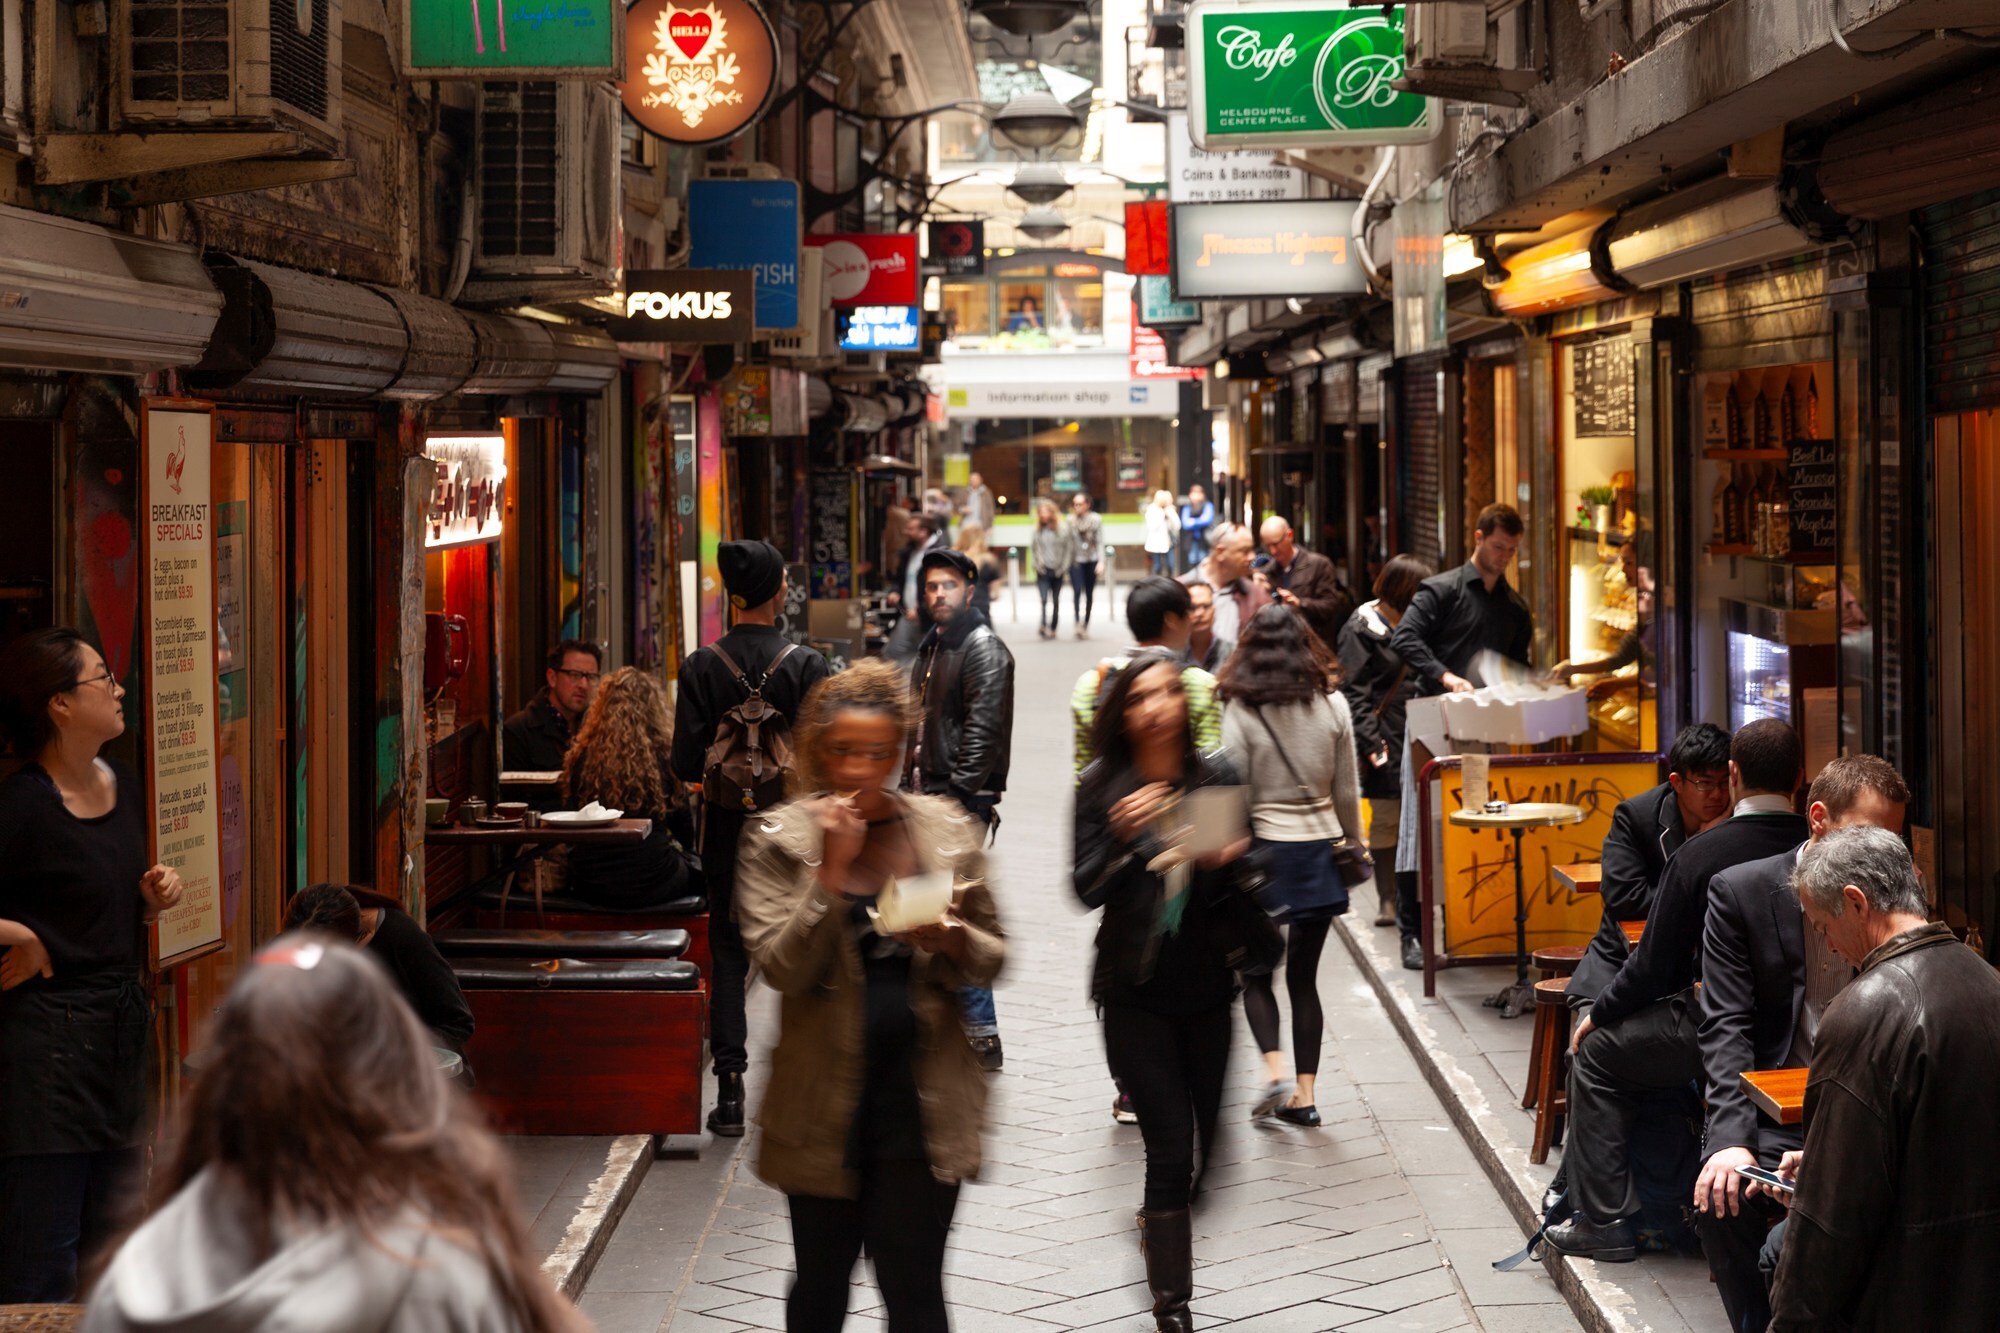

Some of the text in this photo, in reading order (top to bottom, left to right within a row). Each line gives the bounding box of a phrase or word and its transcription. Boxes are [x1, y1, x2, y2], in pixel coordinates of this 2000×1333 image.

[1216, 25, 1297, 81] Cafe
[1219, 107, 1292, 117] MELBOURNE
[1219, 114, 1306, 126] CENTER PLACE
[1182, 167, 1291, 181] Coins & Banknotes
[627, 291, 732, 319] FOKUS
[1075, 391, 1110, 406] shop
[1792, 446, 1817, 462] Beef
[1793, 467, 1835, 485] Moussa
[152, 504, 207, 521] BREAKFAST
[157, 524, 203, 541] SPECIALS
[154, 557, 197, 573] 2 eggs, bacon on
[154, 574, 167, 586] toast
[168, 573, 179, 588] plus
[154, 586, 193, 600] hot drink $9.50
[155, 616, 196, 630] Scrambled eggs,
[156, 630, 206, 648] spinach & parmesan
[156, 650, 162, 660] on
[164, 648, 176, 660] toast
[178, 646, 188, 661] plus
[156, 658, 194, 676] hot drink $9.50
[157, 688, 192, 705] Omelette with
[158, 702, 204, 720] choice of 3 fillings
[158, 725, 164, 735] on
[166, 720, 178, 734] toast
[179, 718, 190, 732] plus
[158, 731, 196, 750] hot drink $9.50
[160, 782, 207, 805] Avocado, sea salt &
[160, 798, 206, 820] lime on sourdough
[160, 816, 188, 836] toast $6.00
[186, 886, 212, 905] QUICKEST
[169, 906, 194, 923] CHEAPEST
